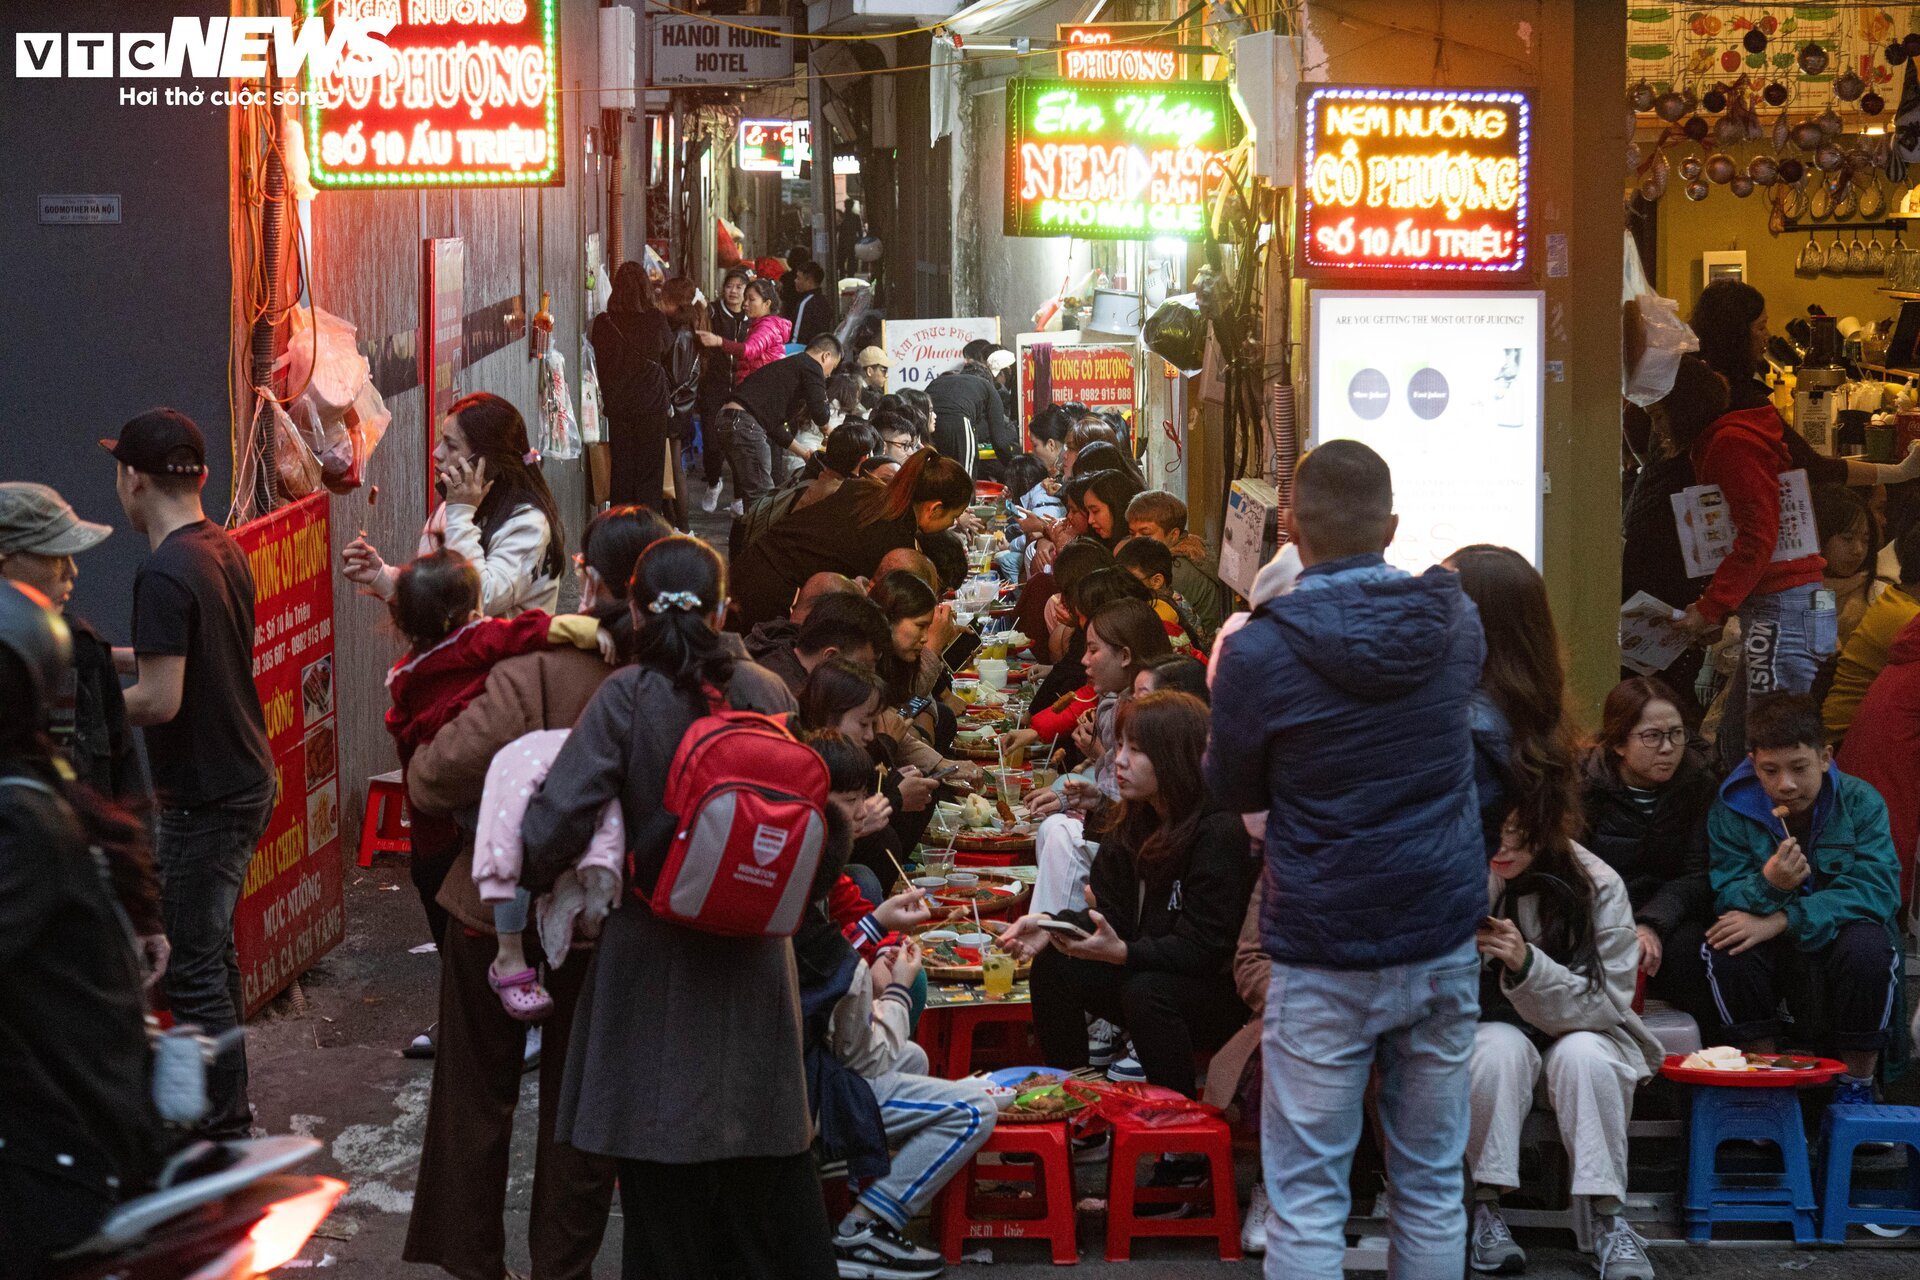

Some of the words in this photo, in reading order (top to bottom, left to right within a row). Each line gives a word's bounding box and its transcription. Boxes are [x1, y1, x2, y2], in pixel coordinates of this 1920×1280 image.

[662, 24, 720, 47] HANOI
[728, 25, 781, 48] HOME
[695, 52, 749, 73] HOTEL
[1326, 105, 1390, 137] NEM
[371, 130, 406, 166] 10
[456, 122, 548, 171] TRIỆU
[1021, 143, 1128, 200] NEM
[1312, 137, 1363, 207] CÔ
[1366, 150, 1520, 221] PHƯỢNG
[44, 205, 89, 214] GODMOTHER
[1358, 226, 1390, 256] 10
[1335, 315, 1351, 325] ARE
[1354, 315, 1370, 325] YOU
[1373, 315, 1410, 325] GETTING
[1412, 315, 1429, 325] THE
[1430, 315, 1455, 325] MOST
[1455, 315, 1473, 325] OUT
[1473, 315, 1486, 325] OF
[1486, 315, 1525, 325] JUICING?
[898, 366, 920, 383] 10
[1081, 353, 1093, 380] CÔ
[1094, 355, 1131, 385] PHƯỢNG
[1080, 389, 1099, 401] 0982
[1101, 388, 1116, 401] 915
[1117, 387, 1132, 401] 088
[307, 624, 319, 648] 915
[245, 960, 261, 1005] CÁ
[969, 1224, 993, 1237] NEM
